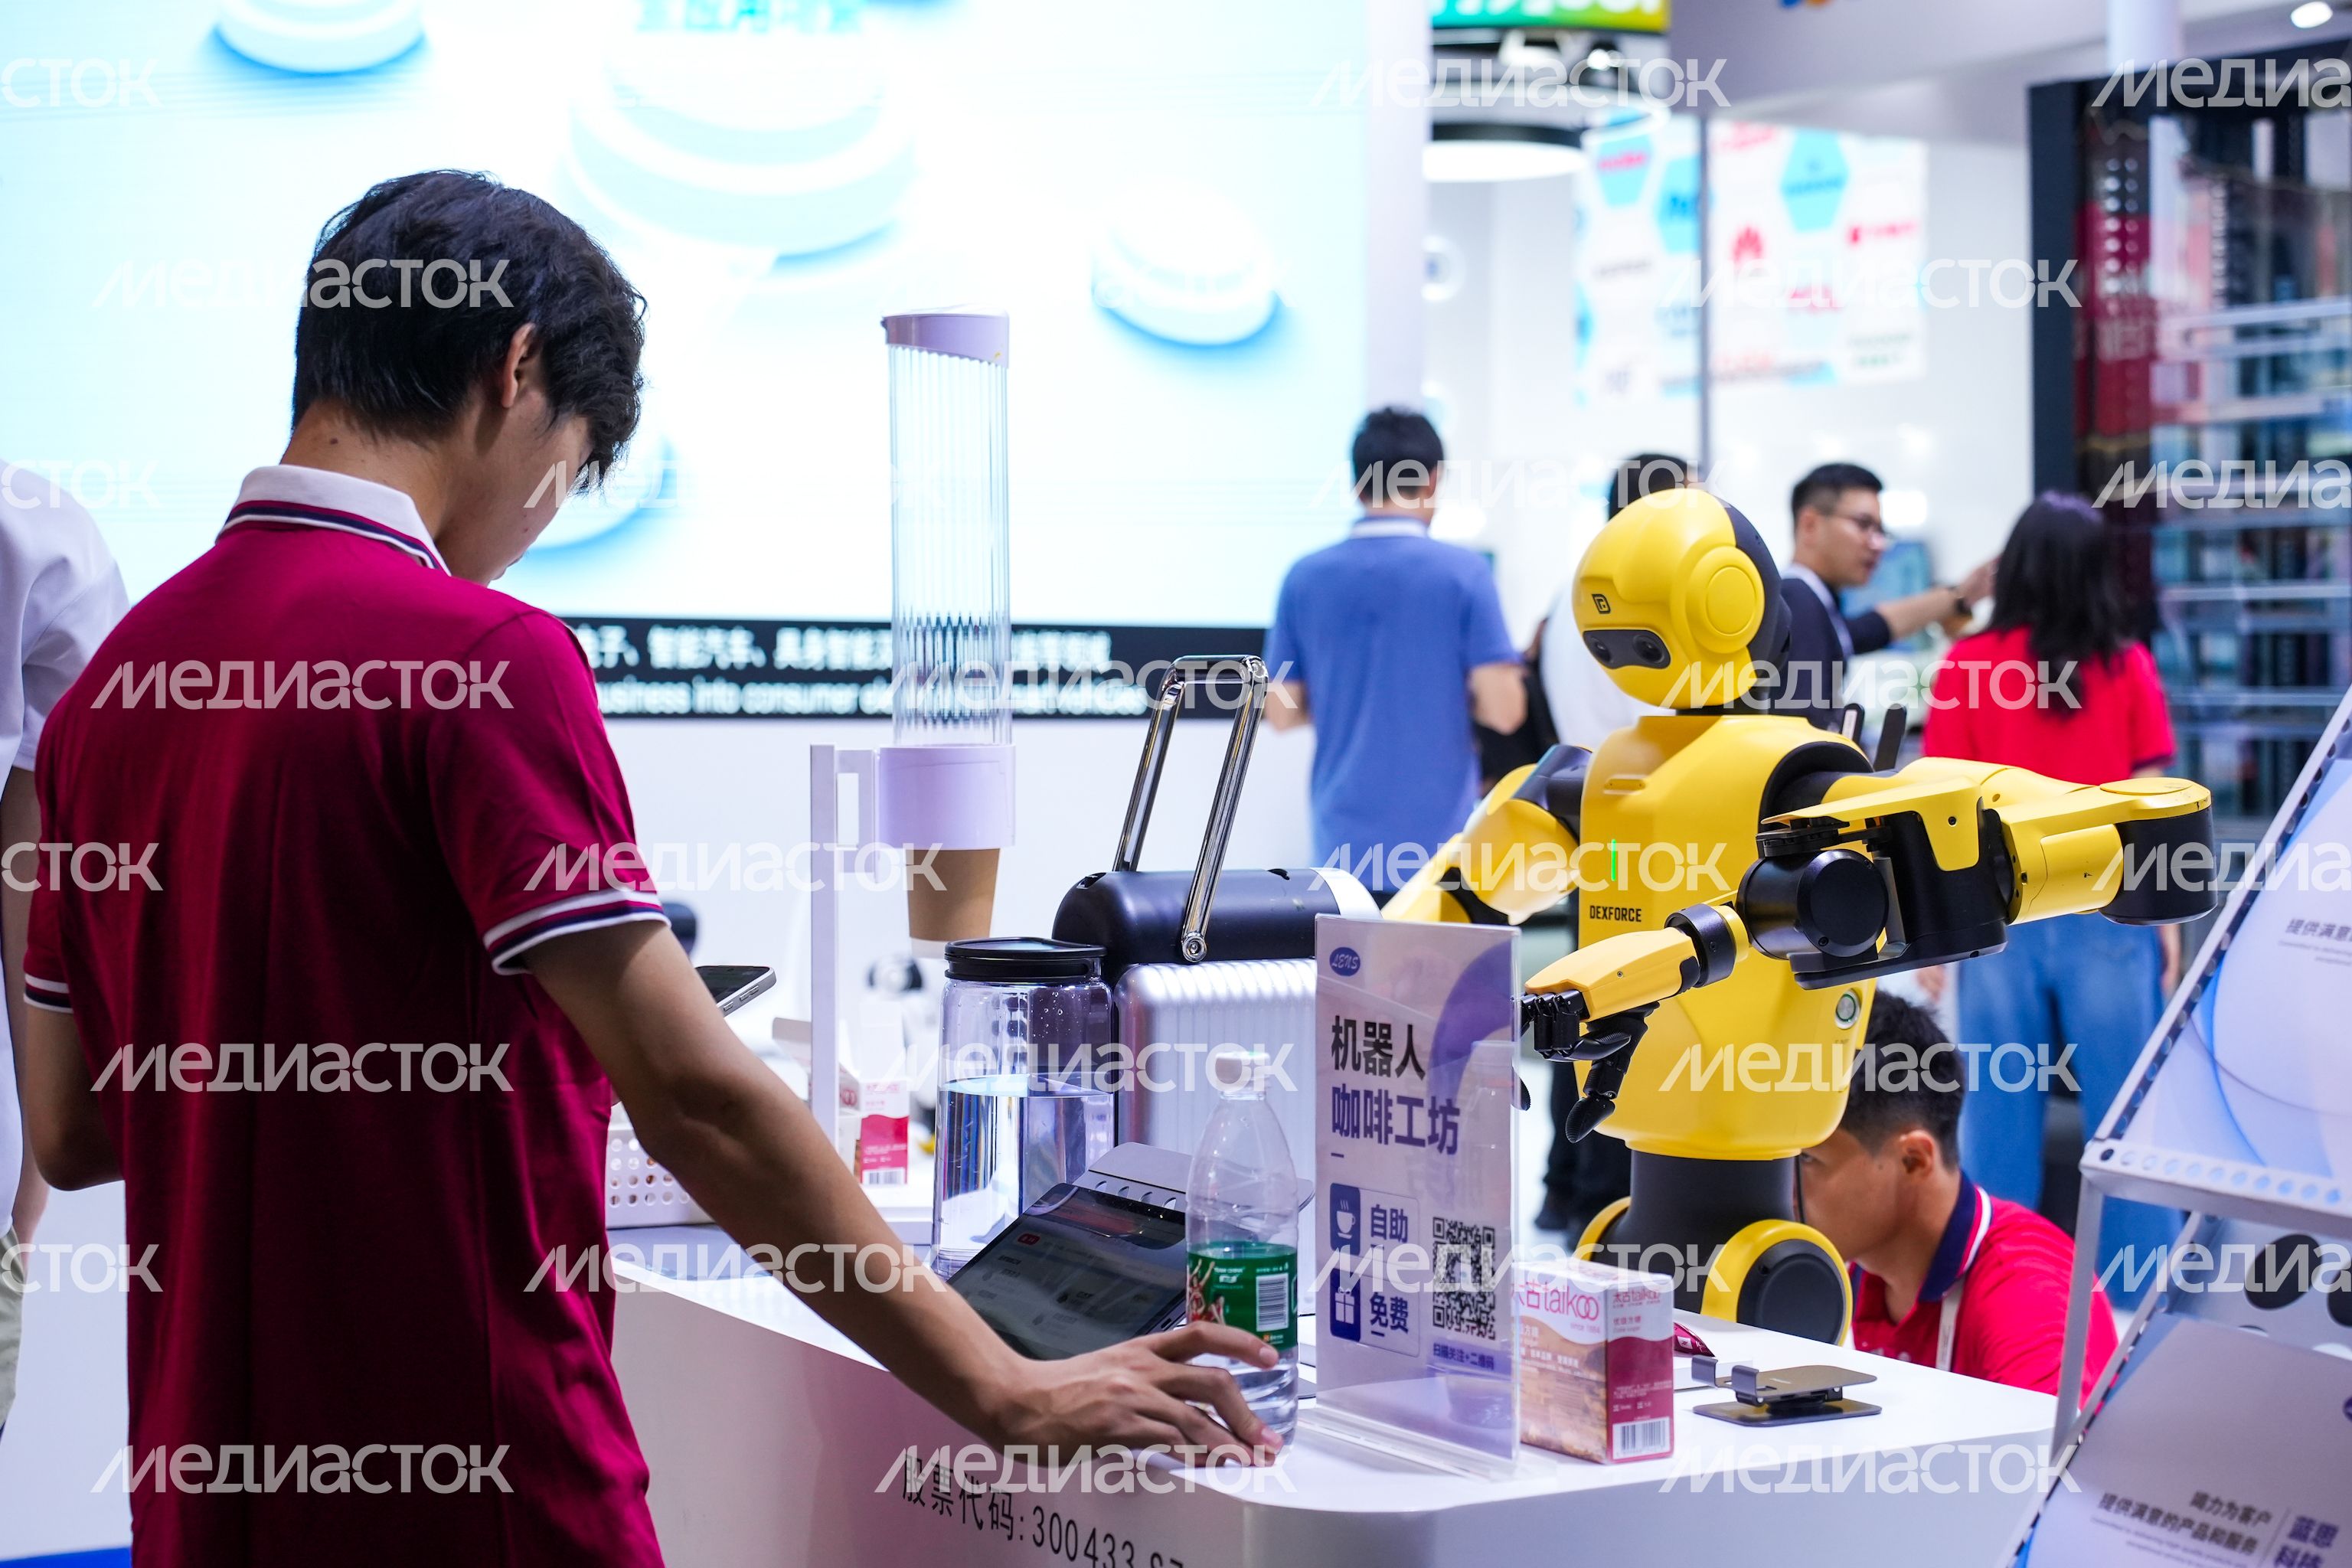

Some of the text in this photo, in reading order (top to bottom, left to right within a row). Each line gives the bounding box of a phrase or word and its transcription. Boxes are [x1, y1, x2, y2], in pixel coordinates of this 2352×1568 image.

[596, 674, 691, 714] usiness
[693, 674, 740, 714] into
[1589, 905, 1642, 923] DEXFORCE
[1331, 1014, 1426, 1081] 机器人
[1331, 1083, 1461, 1156] 咖啡工坊
[1370, 1204, 1408, 1243] 自助
[1370, 1291, 1410, 1334] 免费
